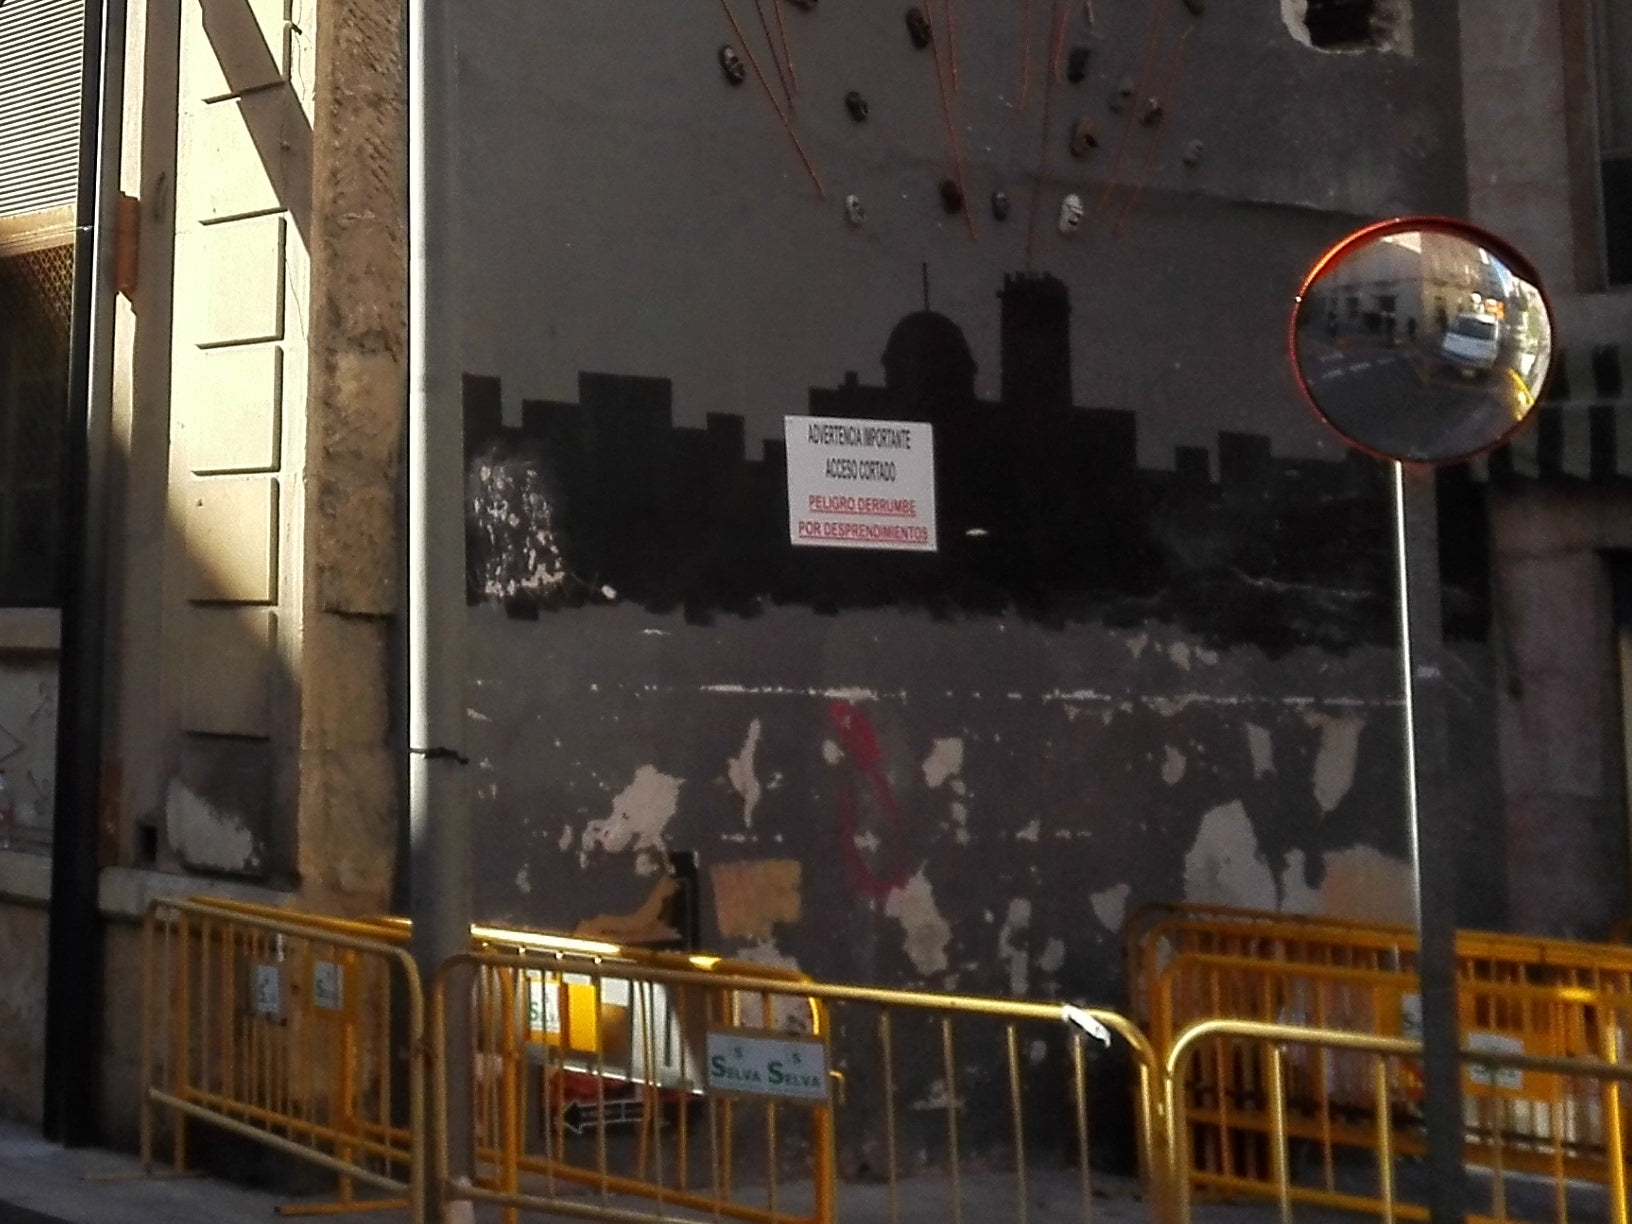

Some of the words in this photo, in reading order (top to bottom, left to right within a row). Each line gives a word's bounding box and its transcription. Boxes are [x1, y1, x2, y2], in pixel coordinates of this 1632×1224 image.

[808, 424, 862, 447] ADVERTENCIA
[863, 426, 911, 450] IMPORTANTE
[825, 457, 857, 480] ACCESO
[859, 459, 896, 482] CORTADO
[808, 494, 855, 512] PELIGRO
[857, 496, 917, 516] DERRUMBE
[798, 520, 821, 537] POR
[823, 521, 929, 543] DESPRENDIMIENTOS
